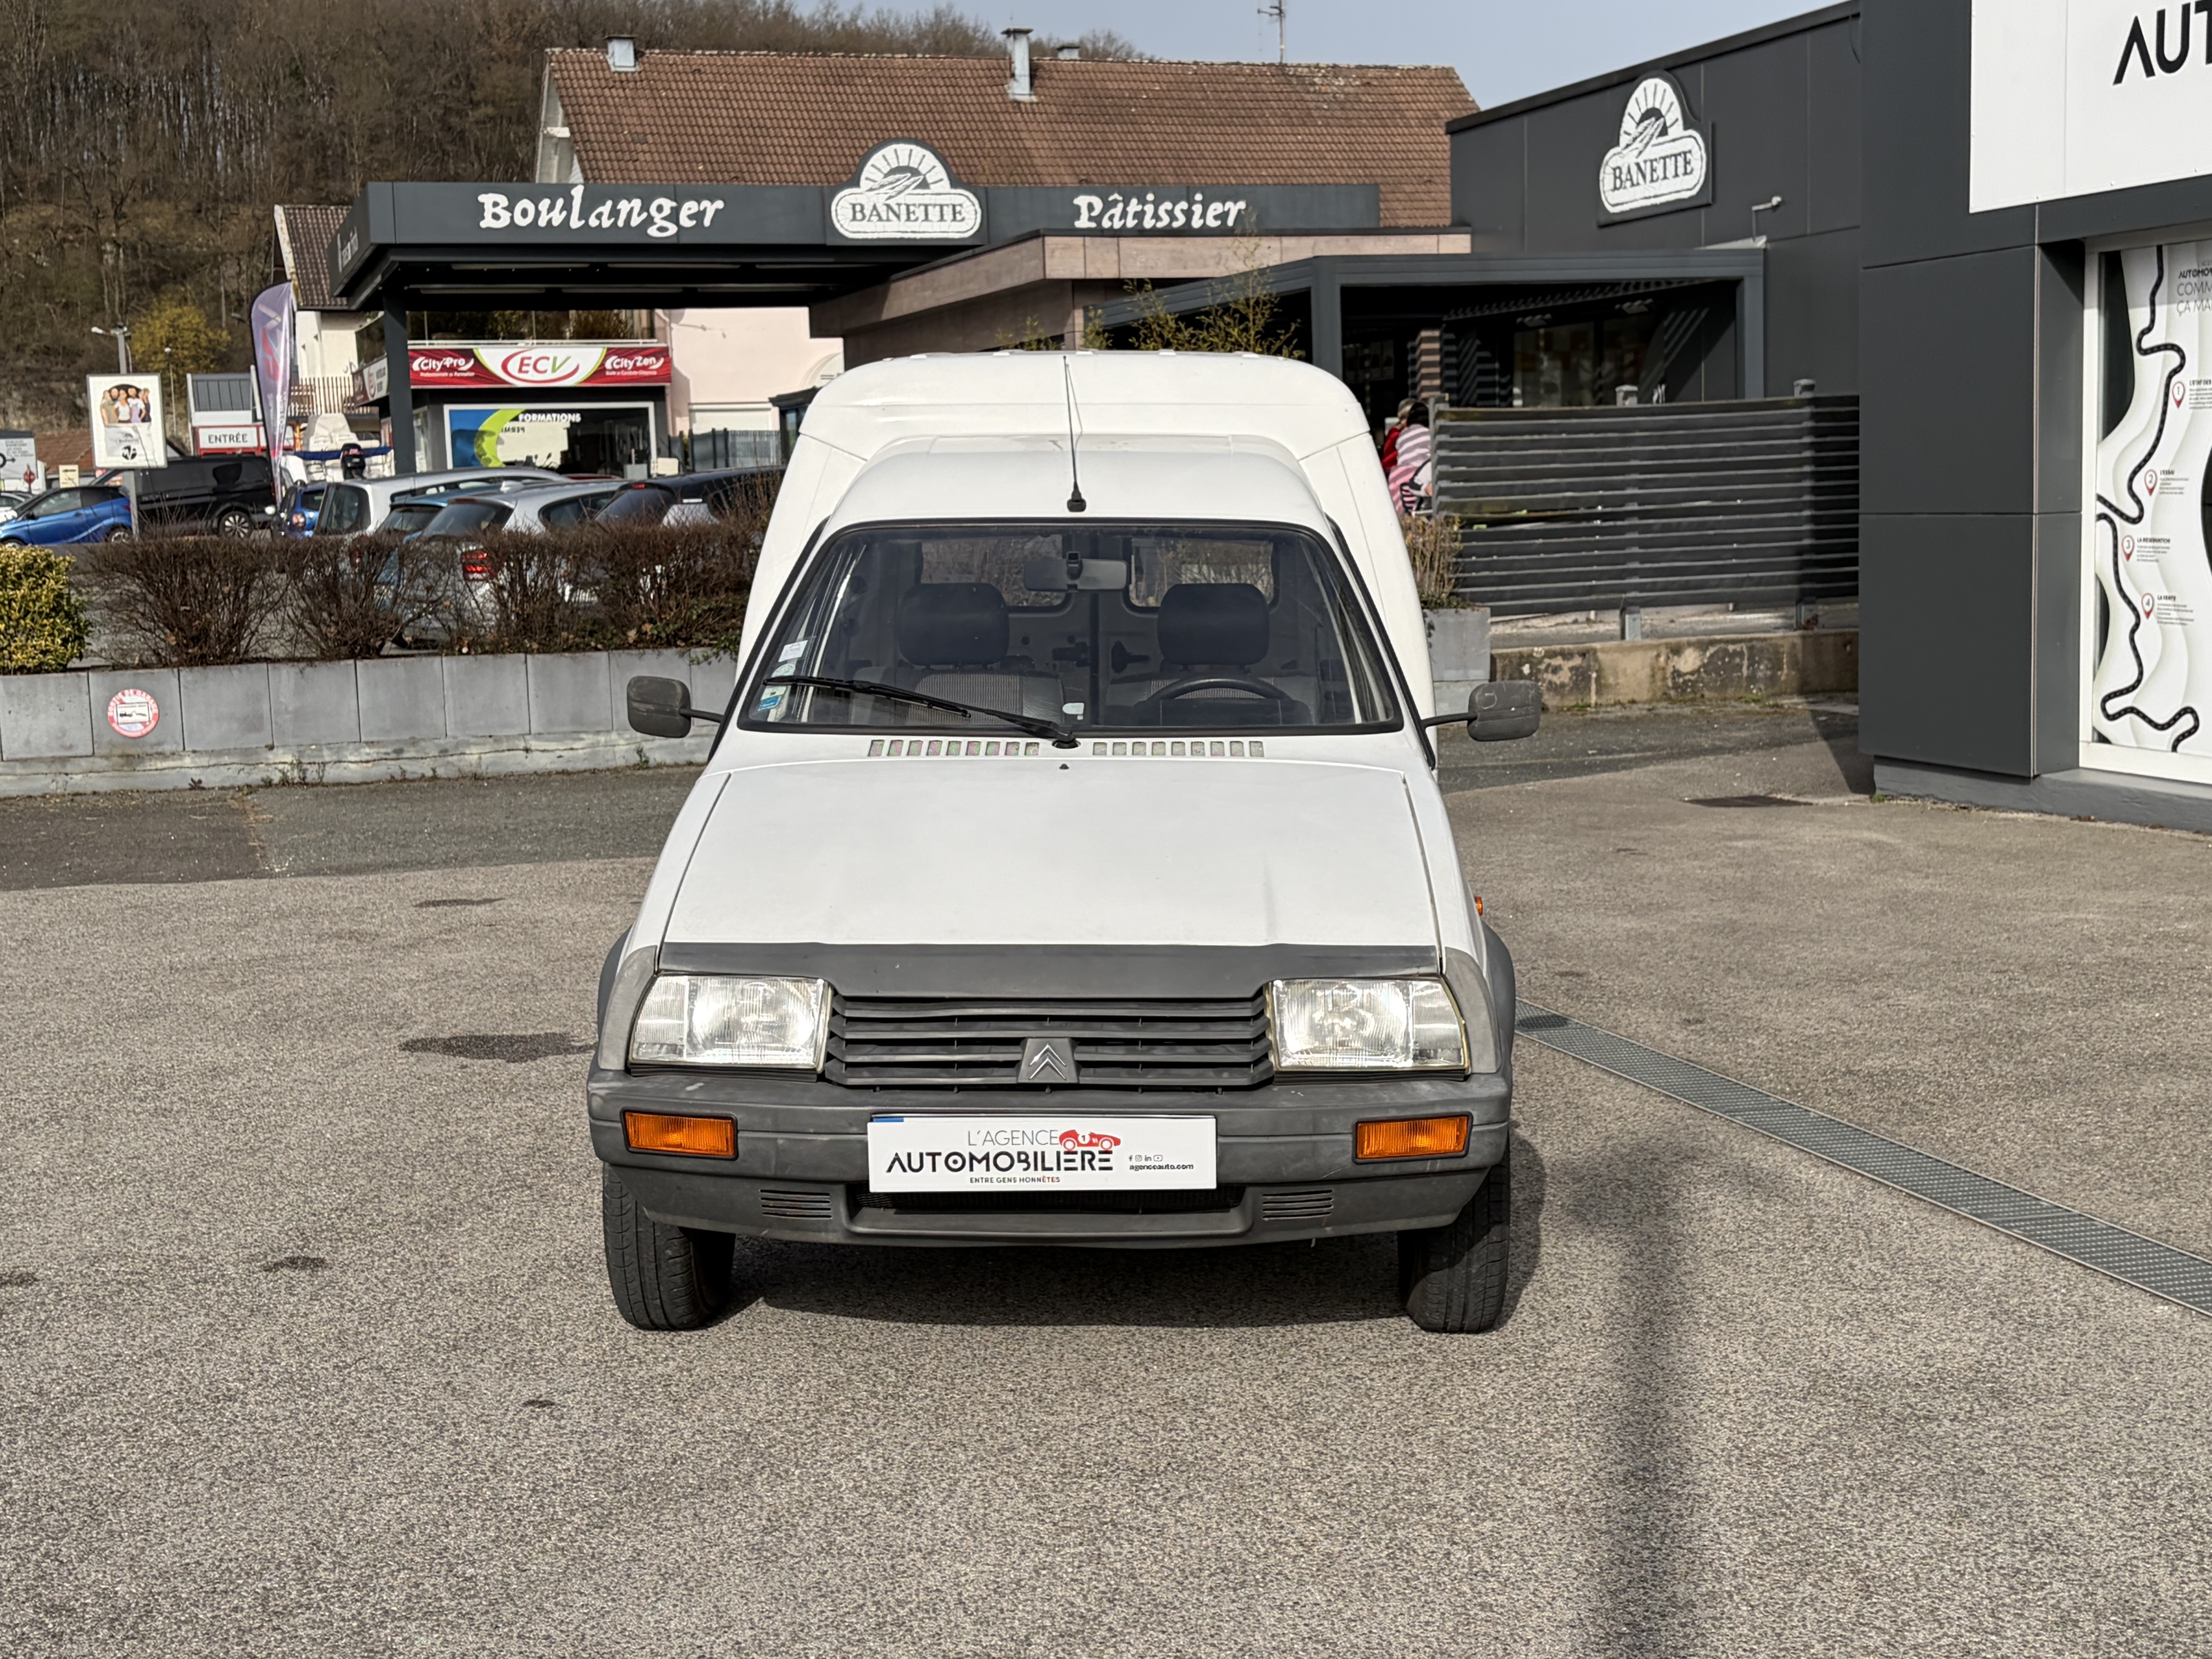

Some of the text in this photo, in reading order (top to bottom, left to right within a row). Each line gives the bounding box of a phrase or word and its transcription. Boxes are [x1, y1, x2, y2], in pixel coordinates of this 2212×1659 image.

[1612, 150, 1694, 192] BANETTE
[478, 185, 725, 237] Boulanger
[851, 202, 966, 223] BANETTE
[1073, 192, 1246, 230] Pâtissier
[2177, 299, 2212, 317] ÇA MA
[517, 356, 572, 374] ECV
[519, 413, 581, 422] FORMATIONS
[208, 432, 248, 444] ENTRÉE
[2148, 474, 2153, 483] 2
[2126, 540, 2130, 549] 3
[968, 1130, 1059, 1146] L'AGENCE
[1019, 1175, 1060, 1183] HONNÊTES
